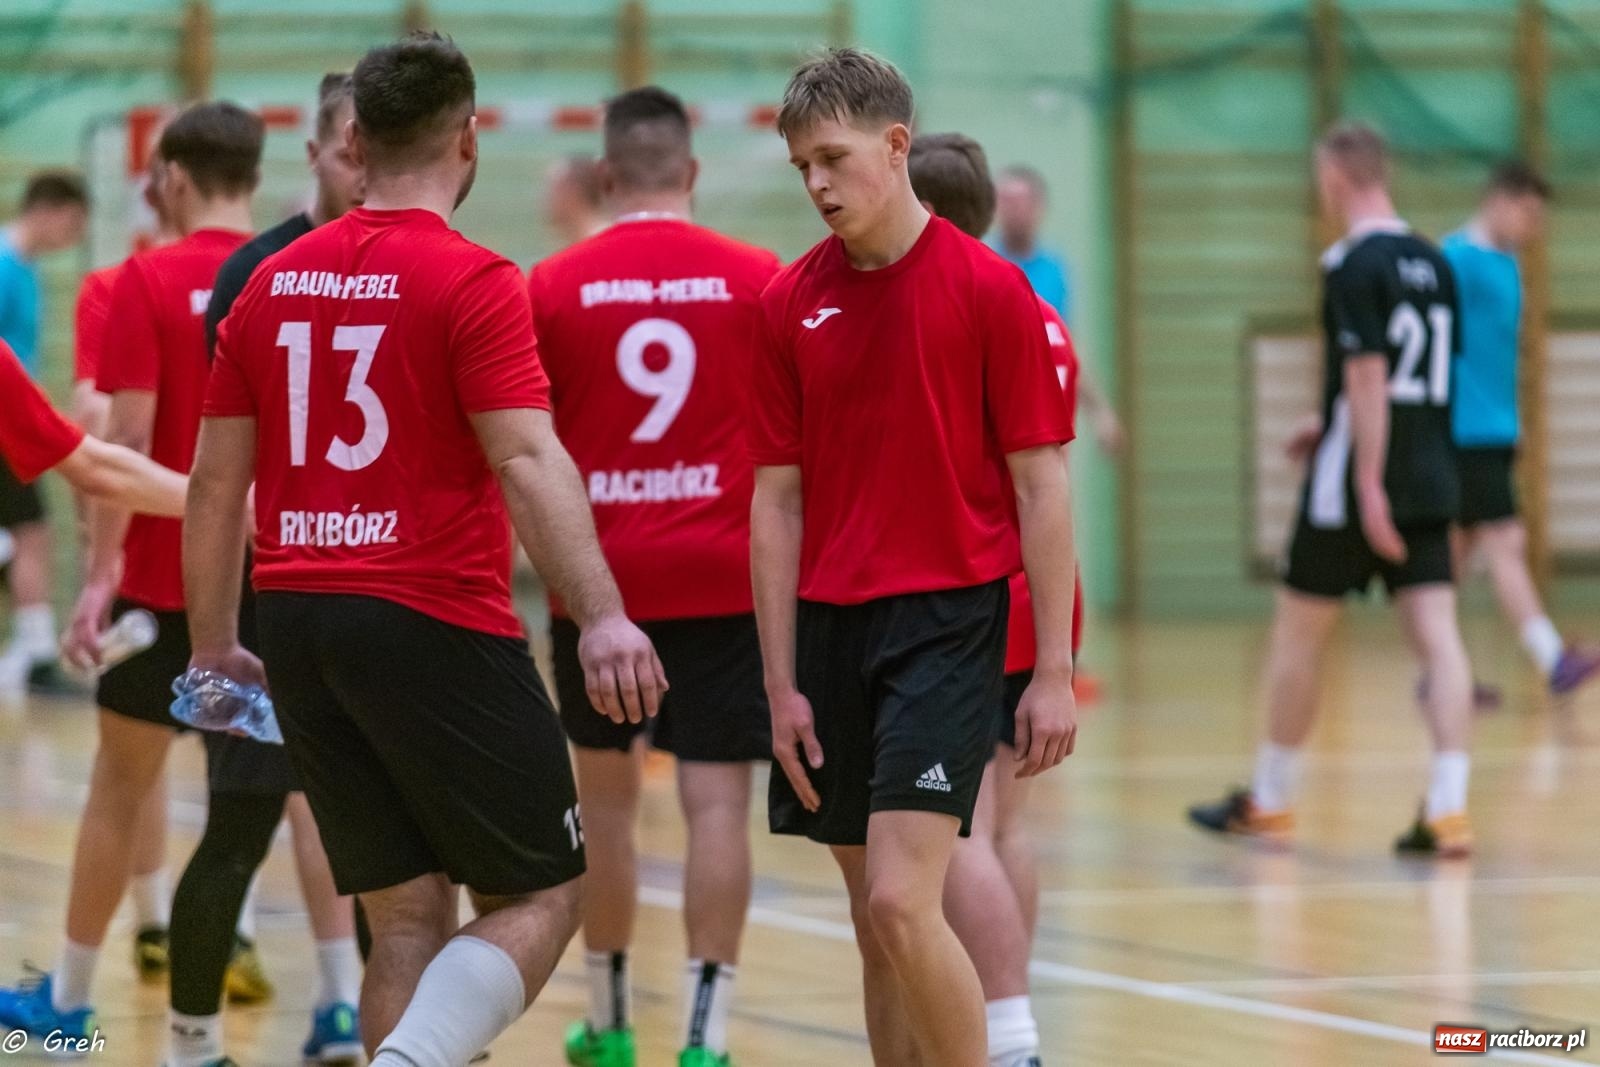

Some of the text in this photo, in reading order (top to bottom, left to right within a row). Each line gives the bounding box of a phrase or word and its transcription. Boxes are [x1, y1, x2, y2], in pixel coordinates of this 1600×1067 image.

[270, 270, 400, 300] BRAUN-MEBEL
[275, 321, 389, 471] 13
[616, 317, 697, 442] 9
[1386, 302, 1453, 405] 21
[915, 779, 952, 792] adidas
